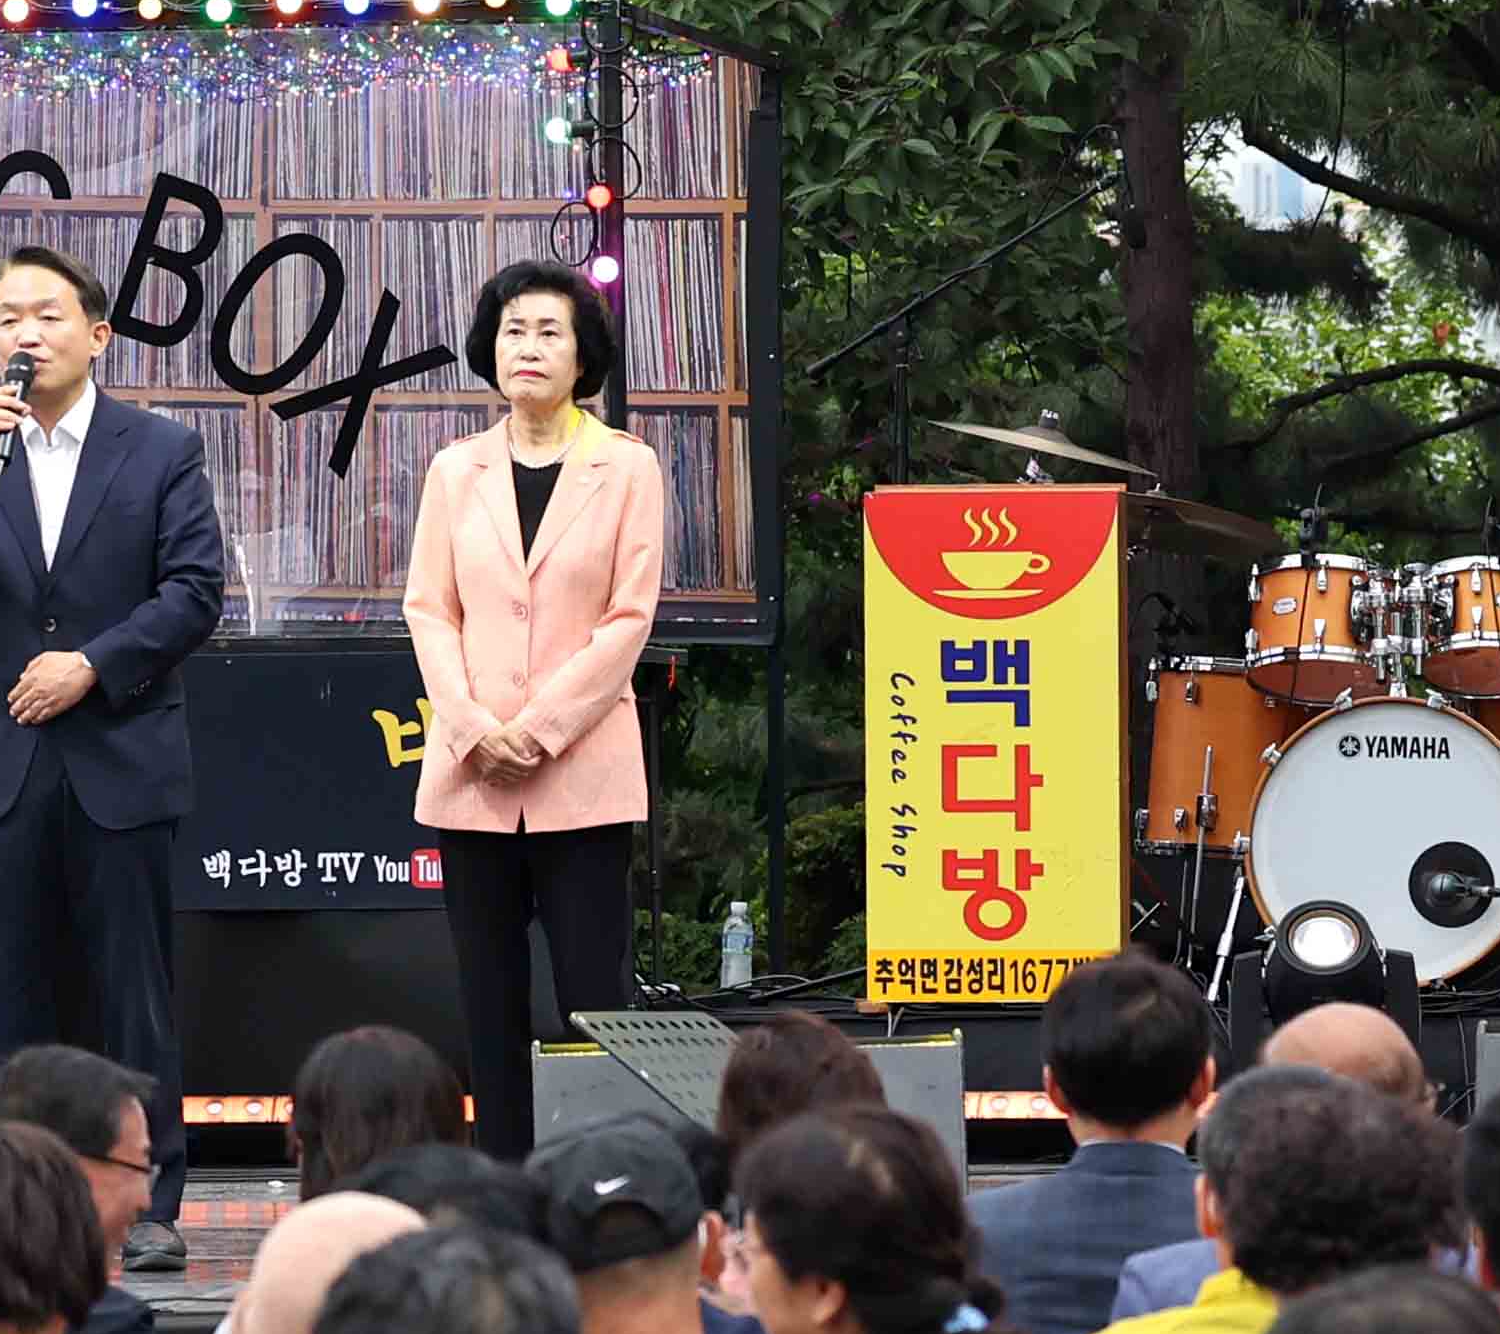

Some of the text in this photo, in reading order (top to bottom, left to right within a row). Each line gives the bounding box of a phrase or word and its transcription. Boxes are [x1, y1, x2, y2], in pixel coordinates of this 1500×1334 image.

[110, 171, 458, 480] BOX
[890, 672, 918, 784] Coffee
[1366, 736, 1451, 759] YAMAHA
[940, 639, 1045, 942] 백다방
[202, 849, 444, 889] 백다방 TV YouTu
[1009, 956, 1092, 994] 1677
